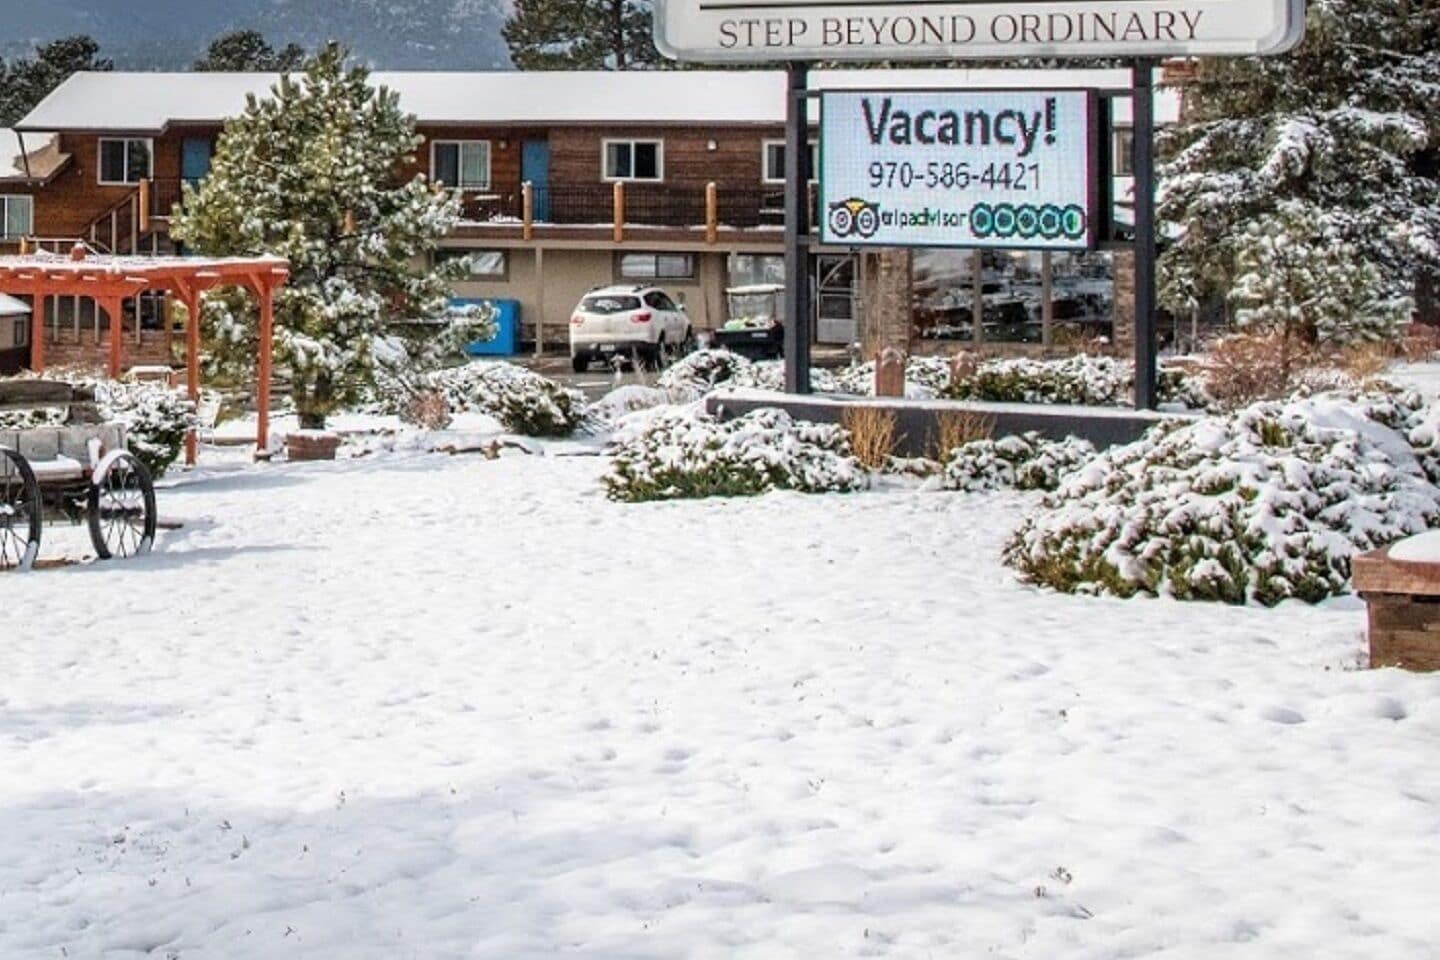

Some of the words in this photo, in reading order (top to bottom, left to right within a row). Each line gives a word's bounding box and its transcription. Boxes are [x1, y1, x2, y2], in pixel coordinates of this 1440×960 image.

[719, 18, 808, 48] STEP
[822, 14, 977, 45] BEYOND
[990, 10, 1203, 42] ORDINARY
[862, 97, 1057, 157] Vacancy!
[869, 161, 1040, 190] 970-586-4421
[881, 207, 969, 228] tripadvisor
